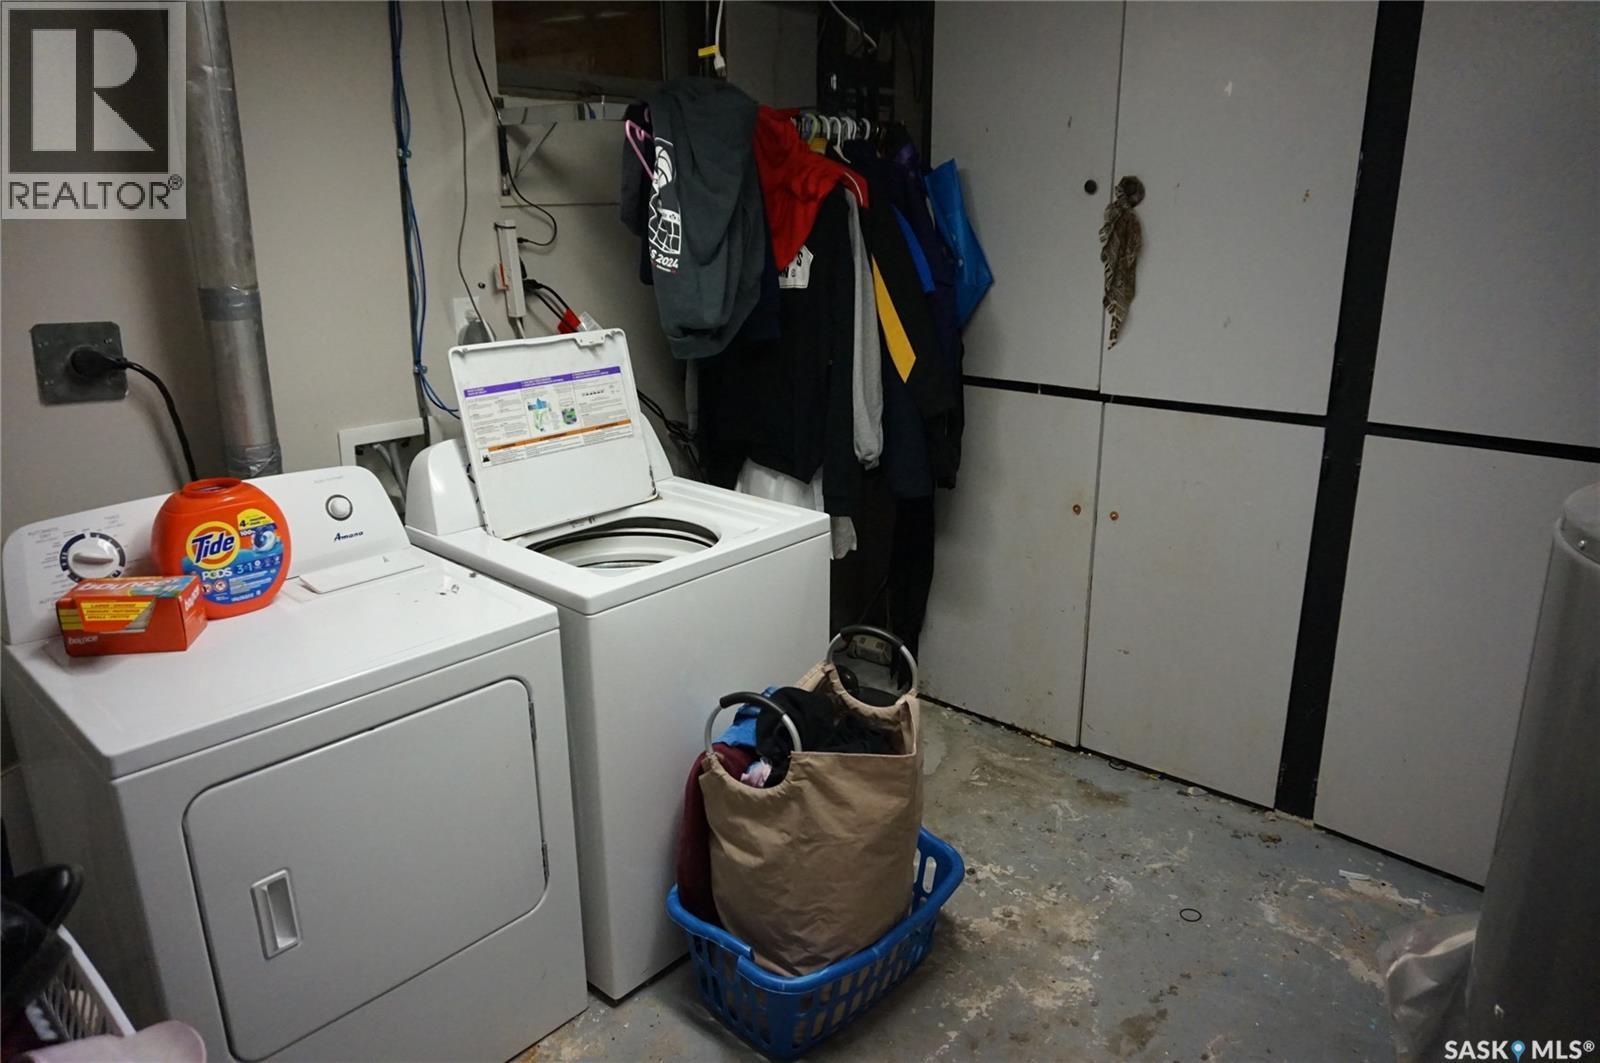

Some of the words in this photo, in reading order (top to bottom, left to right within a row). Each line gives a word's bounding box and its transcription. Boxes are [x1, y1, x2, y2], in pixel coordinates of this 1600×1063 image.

[655, 253, 679, 269] 2024
[334, 531, 364, 542] Amana
[192, 532, 236, 564] Tide
[201, 567, 233, 581] PODS
